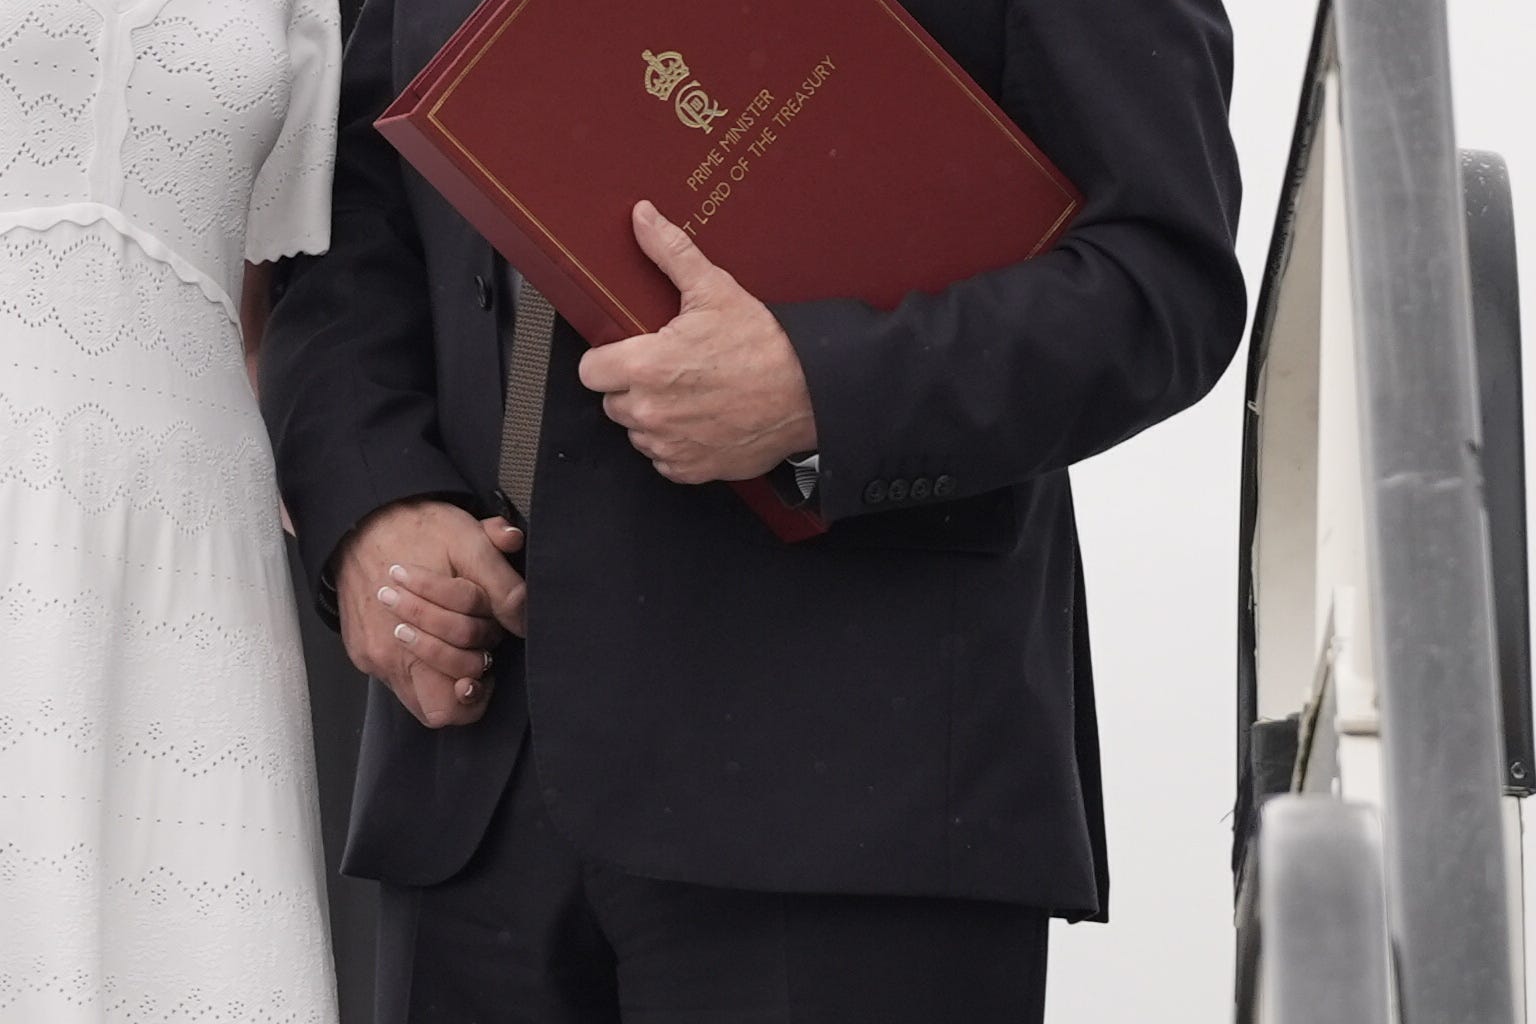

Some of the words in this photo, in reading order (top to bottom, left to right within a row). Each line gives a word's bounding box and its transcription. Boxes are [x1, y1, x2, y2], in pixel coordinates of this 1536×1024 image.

[686, 148, 725, 192] PRIME
[719, 88, 775, 153] MINISTER
[693, 182, 731, 225] LORD
[730, 157, 750, 181] OF
[747, 126, 777, 157] THE
[772, 55, 836, 128] TREASURY
